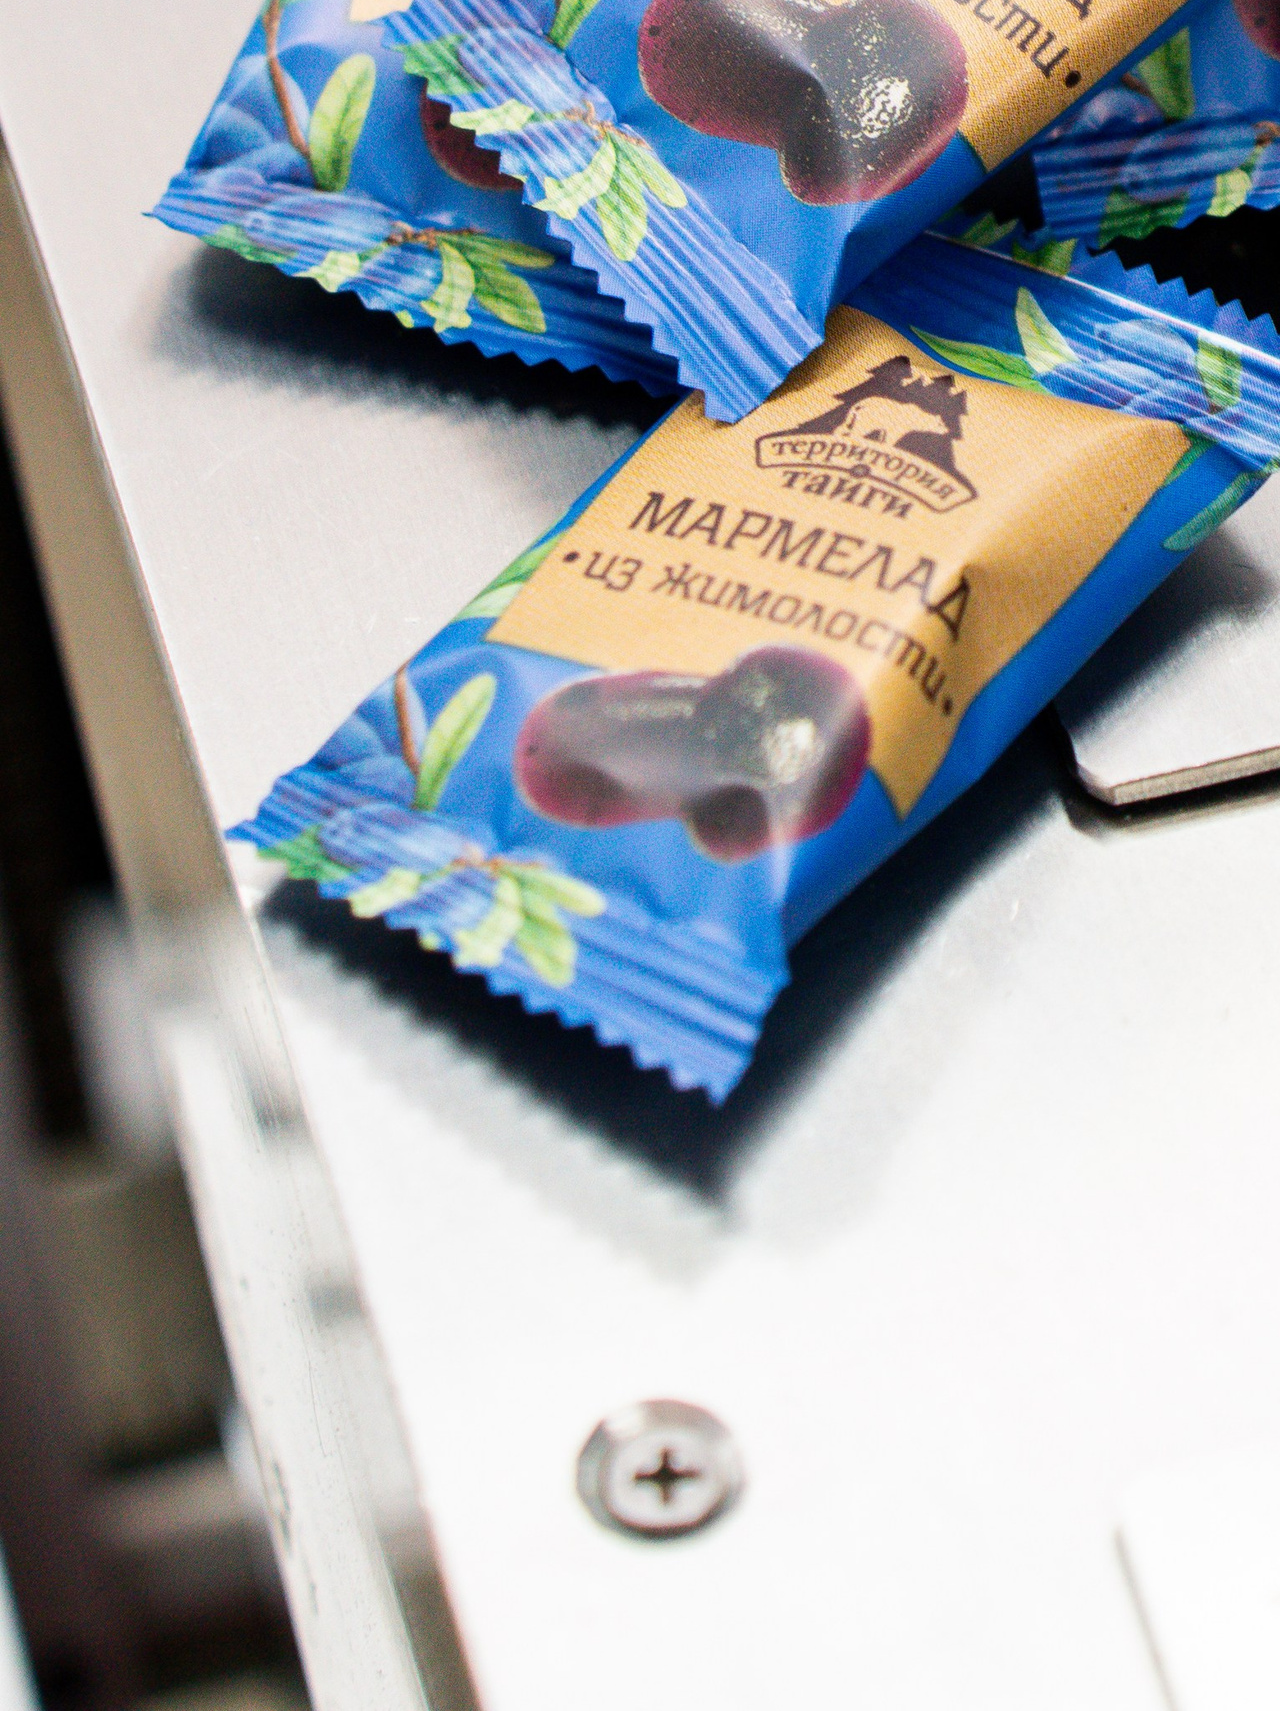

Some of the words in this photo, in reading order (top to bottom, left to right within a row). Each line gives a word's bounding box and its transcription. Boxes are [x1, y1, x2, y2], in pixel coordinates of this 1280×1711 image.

[770, 437, 958, 501] территория
[782, 468, 916, 520] тайги
[628, 490, 972, 646] МАРМЕЛАД
